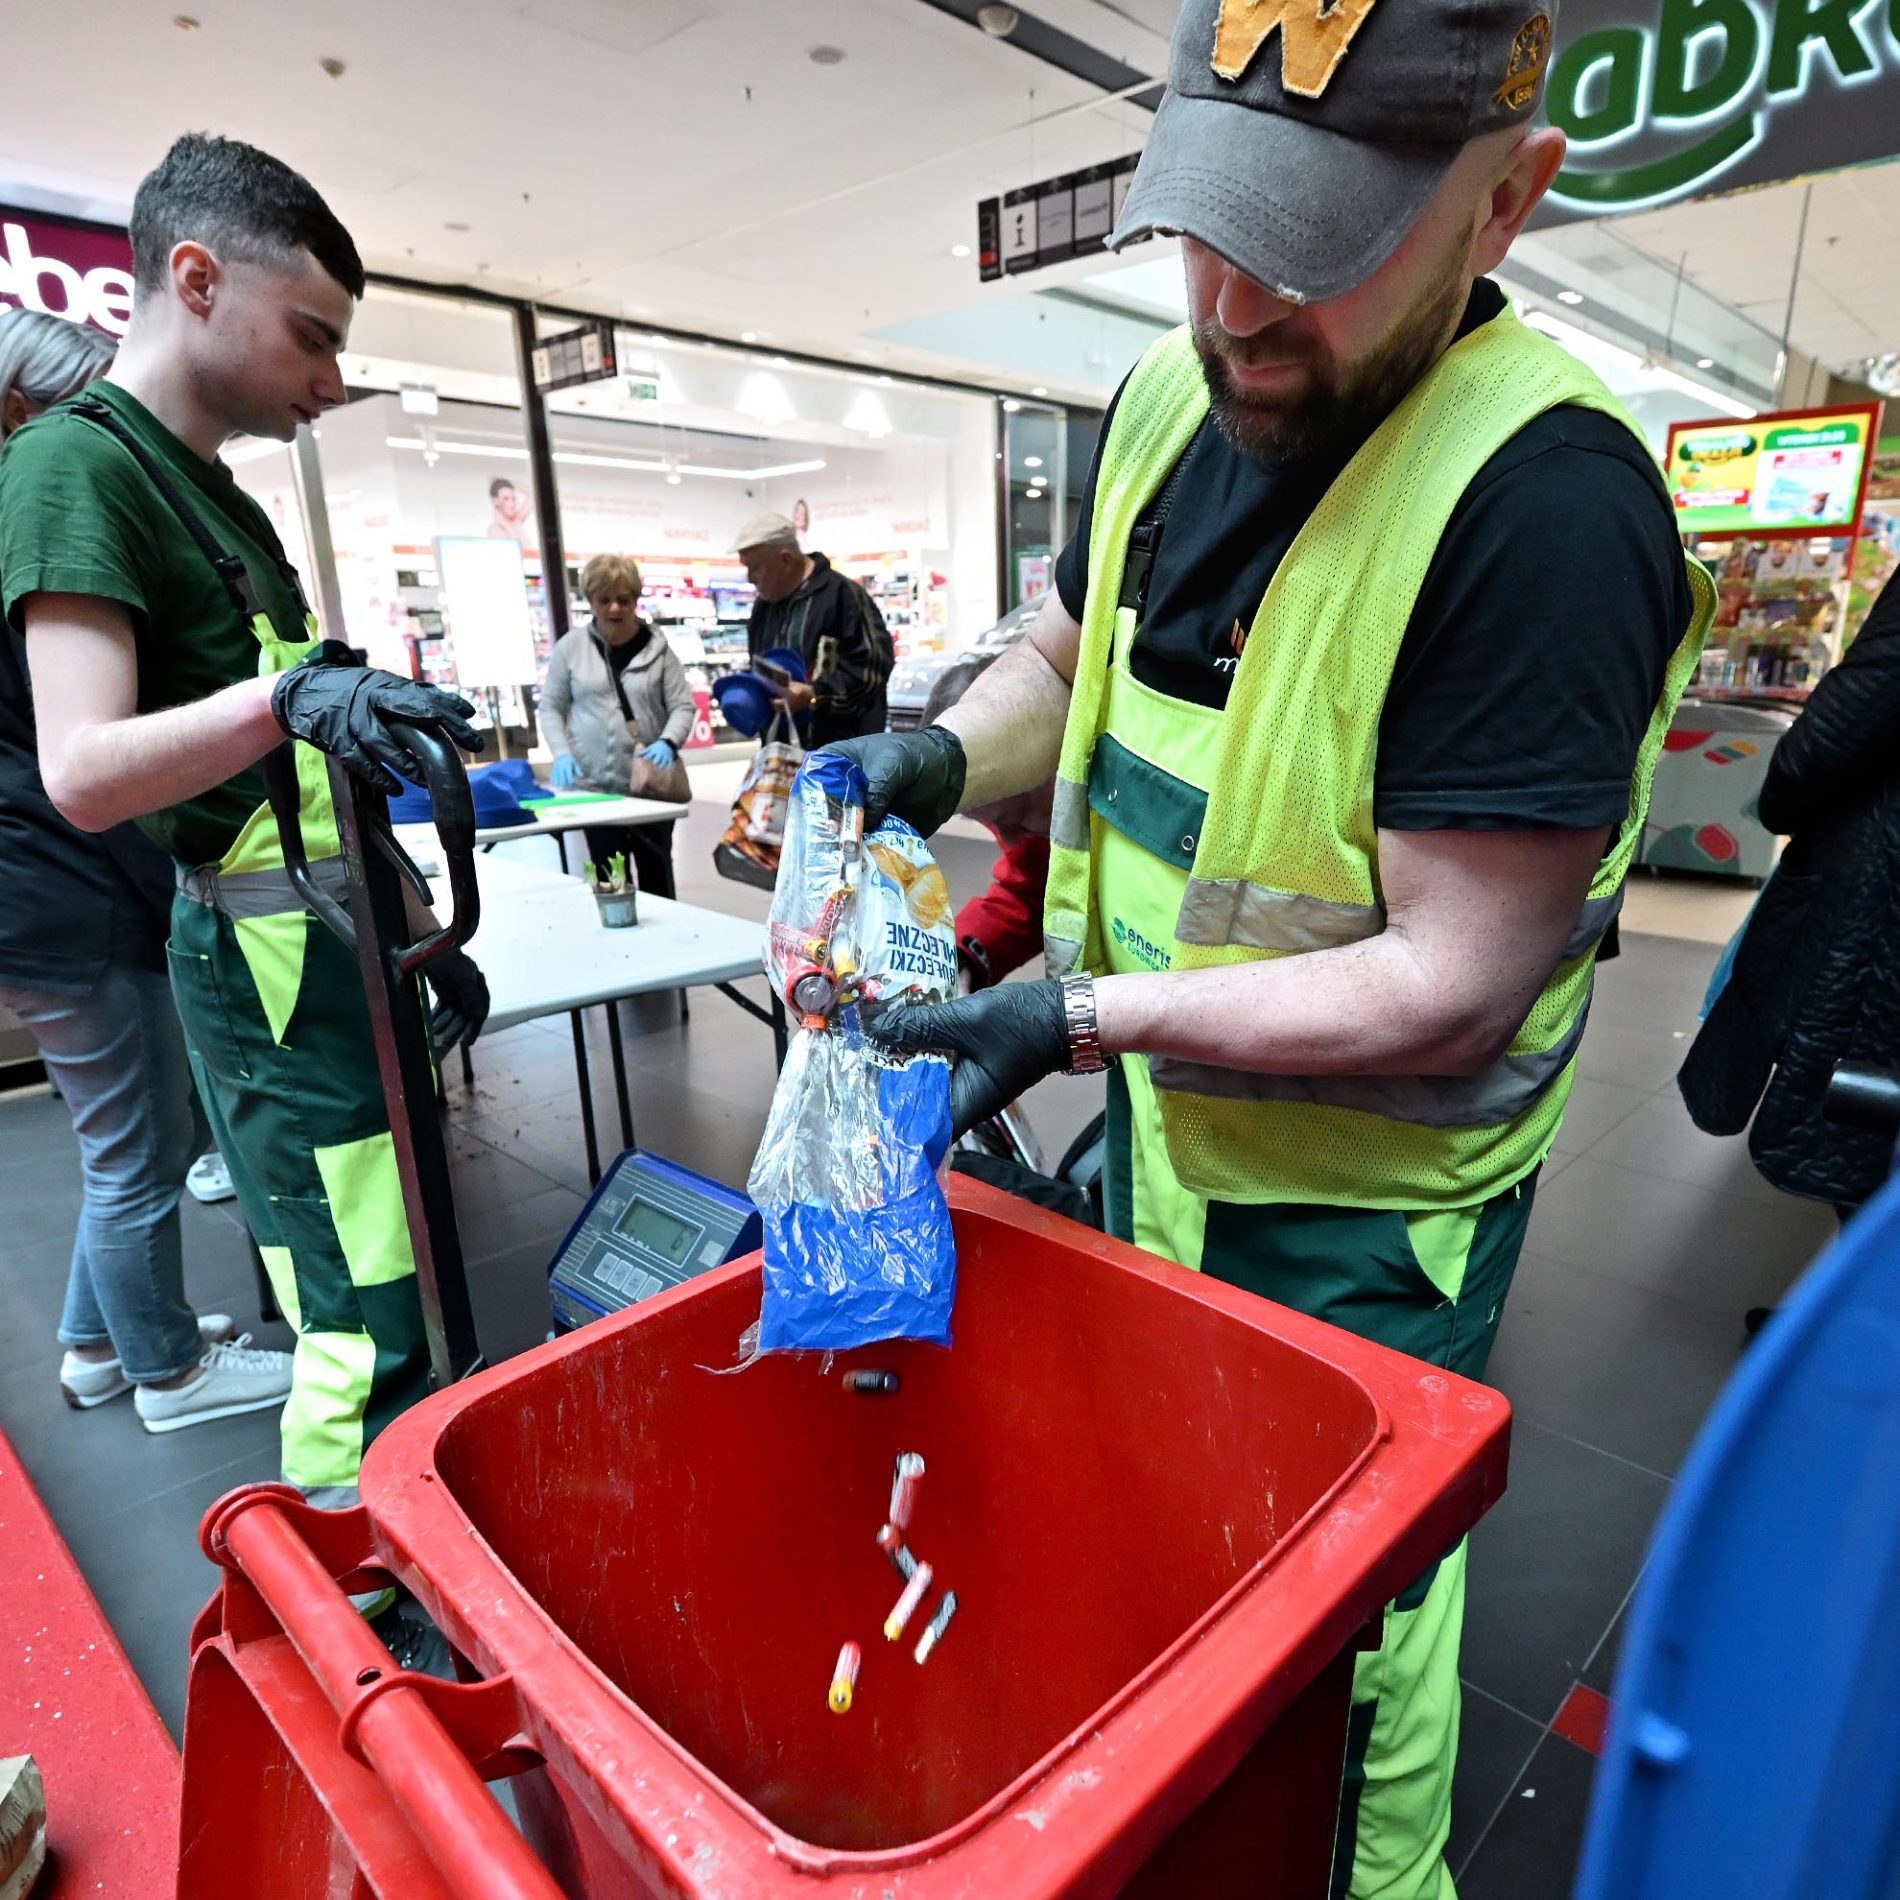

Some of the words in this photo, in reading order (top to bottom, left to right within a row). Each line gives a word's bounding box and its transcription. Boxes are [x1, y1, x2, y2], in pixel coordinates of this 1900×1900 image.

[1210, 0, 1375, 98] W
[1545, 0, 1900, 145] abk
[886, 921, 956, 967] MLECZNE
[1128, 928, 1171, 970] eneris
[889, 949, 955, 986] BUŁECZKI
